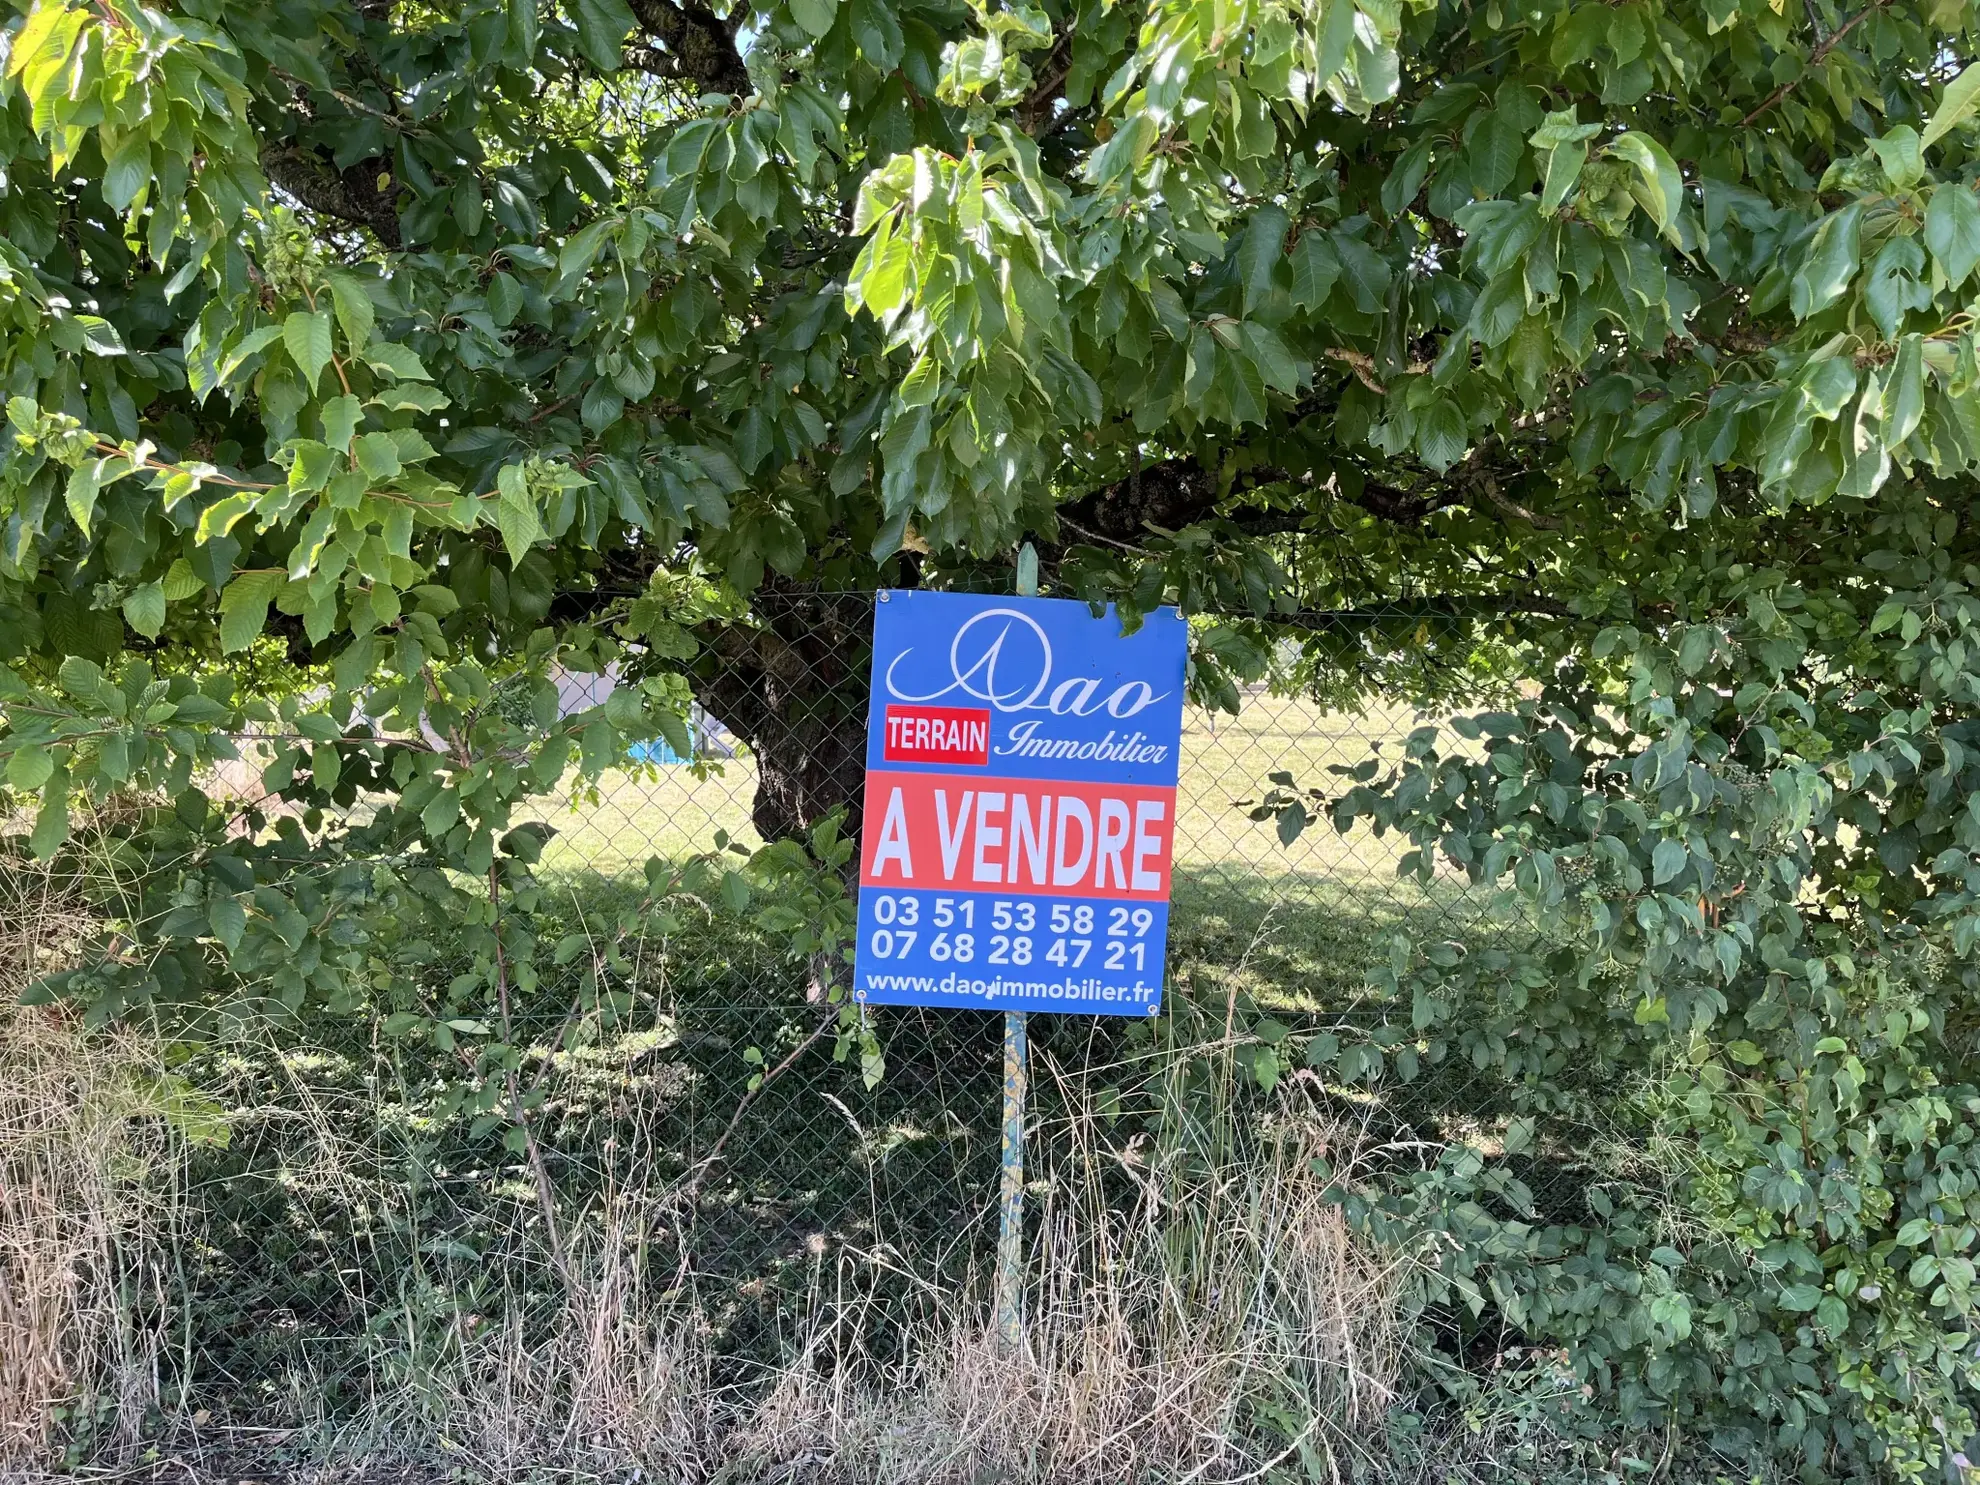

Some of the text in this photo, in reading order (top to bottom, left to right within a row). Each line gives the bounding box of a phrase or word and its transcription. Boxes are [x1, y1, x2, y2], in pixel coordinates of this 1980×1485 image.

[886, 608, 1172, 718] Dao
[887, 716, 986, 752] TERRAIN
[993, 720, 1168, 764] Immobilier
[870, 786, 1166, 892] A VENDRE
[874, 895, 1153, 938] 03 51 53 58 29
[871, 929, 1145, 971] 07 68 28 47 21
